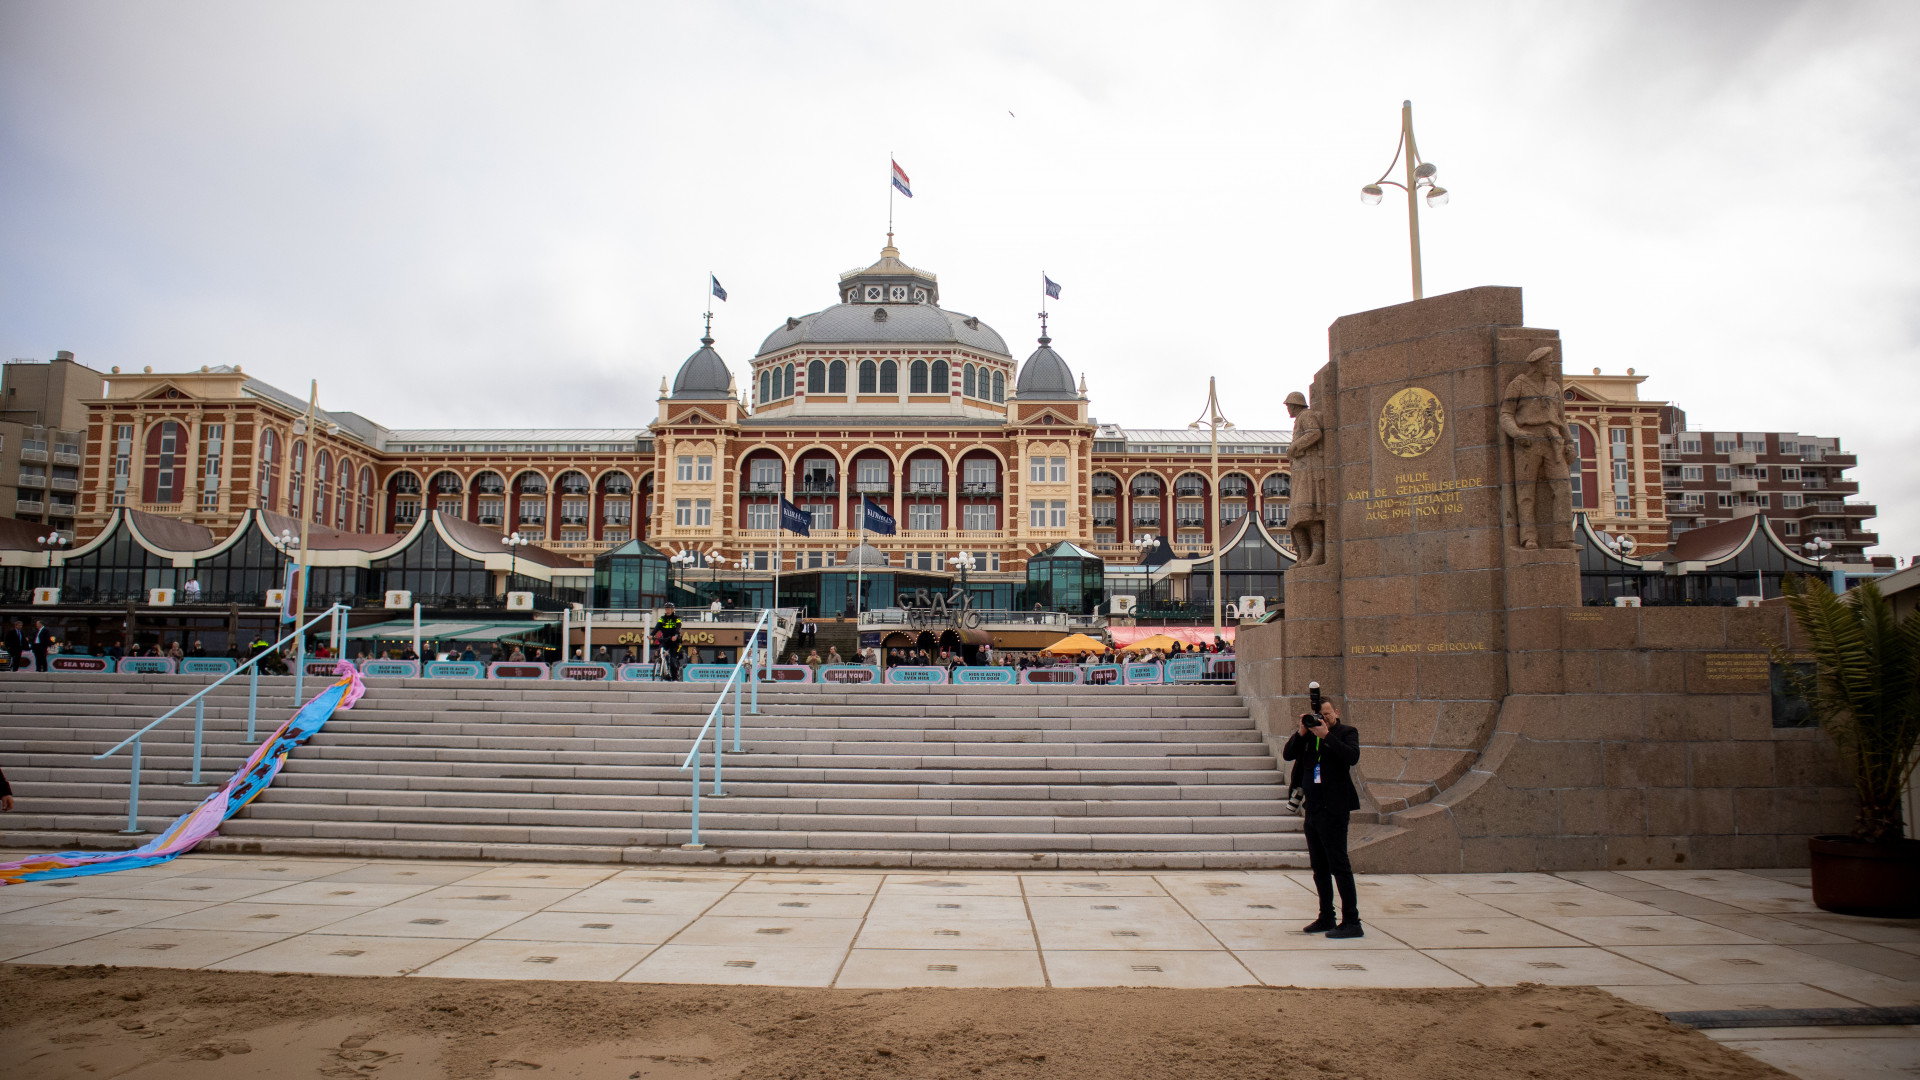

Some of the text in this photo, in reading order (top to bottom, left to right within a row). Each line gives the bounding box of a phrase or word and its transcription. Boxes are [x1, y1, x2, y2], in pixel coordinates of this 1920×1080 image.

[1396, 472, 1430, 484] HULDE
[1346, 478, 1482, 500] AAN DE GEMOBILISEERDE
[1366, 511, 1389, 520] AUG.
[1416, 506, 1440, 516] NOV.
[1444, 504, 1463, 514] 1918
[898, 588, 974, 617] CRAZY
[1352, 646, 1366, 654] HET
